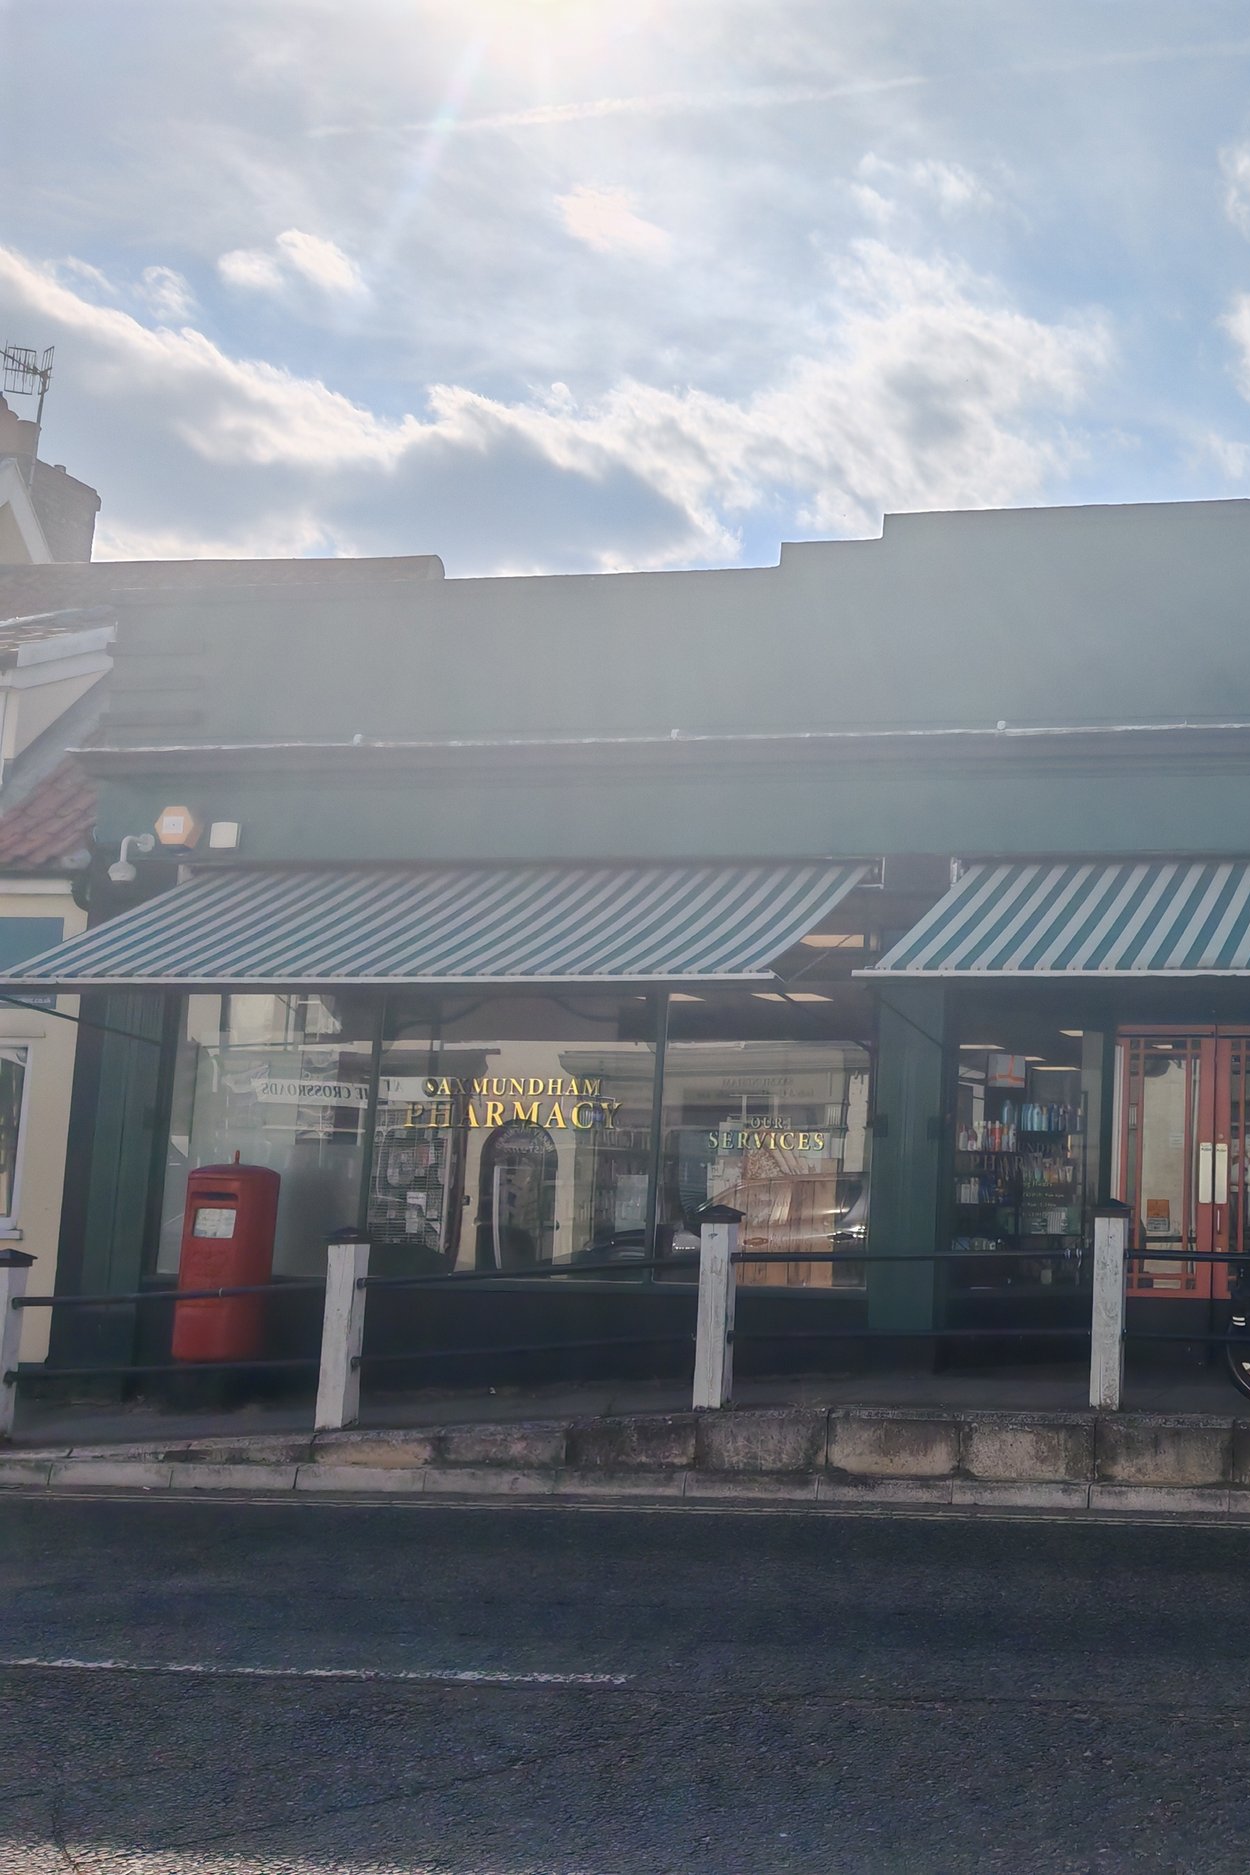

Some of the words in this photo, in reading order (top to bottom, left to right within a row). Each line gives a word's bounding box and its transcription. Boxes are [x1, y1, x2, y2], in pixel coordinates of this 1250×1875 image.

[424, 1078, 601, 1096] SAXMUNDHAM
[404, 1101, 623, 1129] PHARMACY
[750, 1117, 784, 1129] OUR
[708, 1132, 825, 1150] SERVICES
